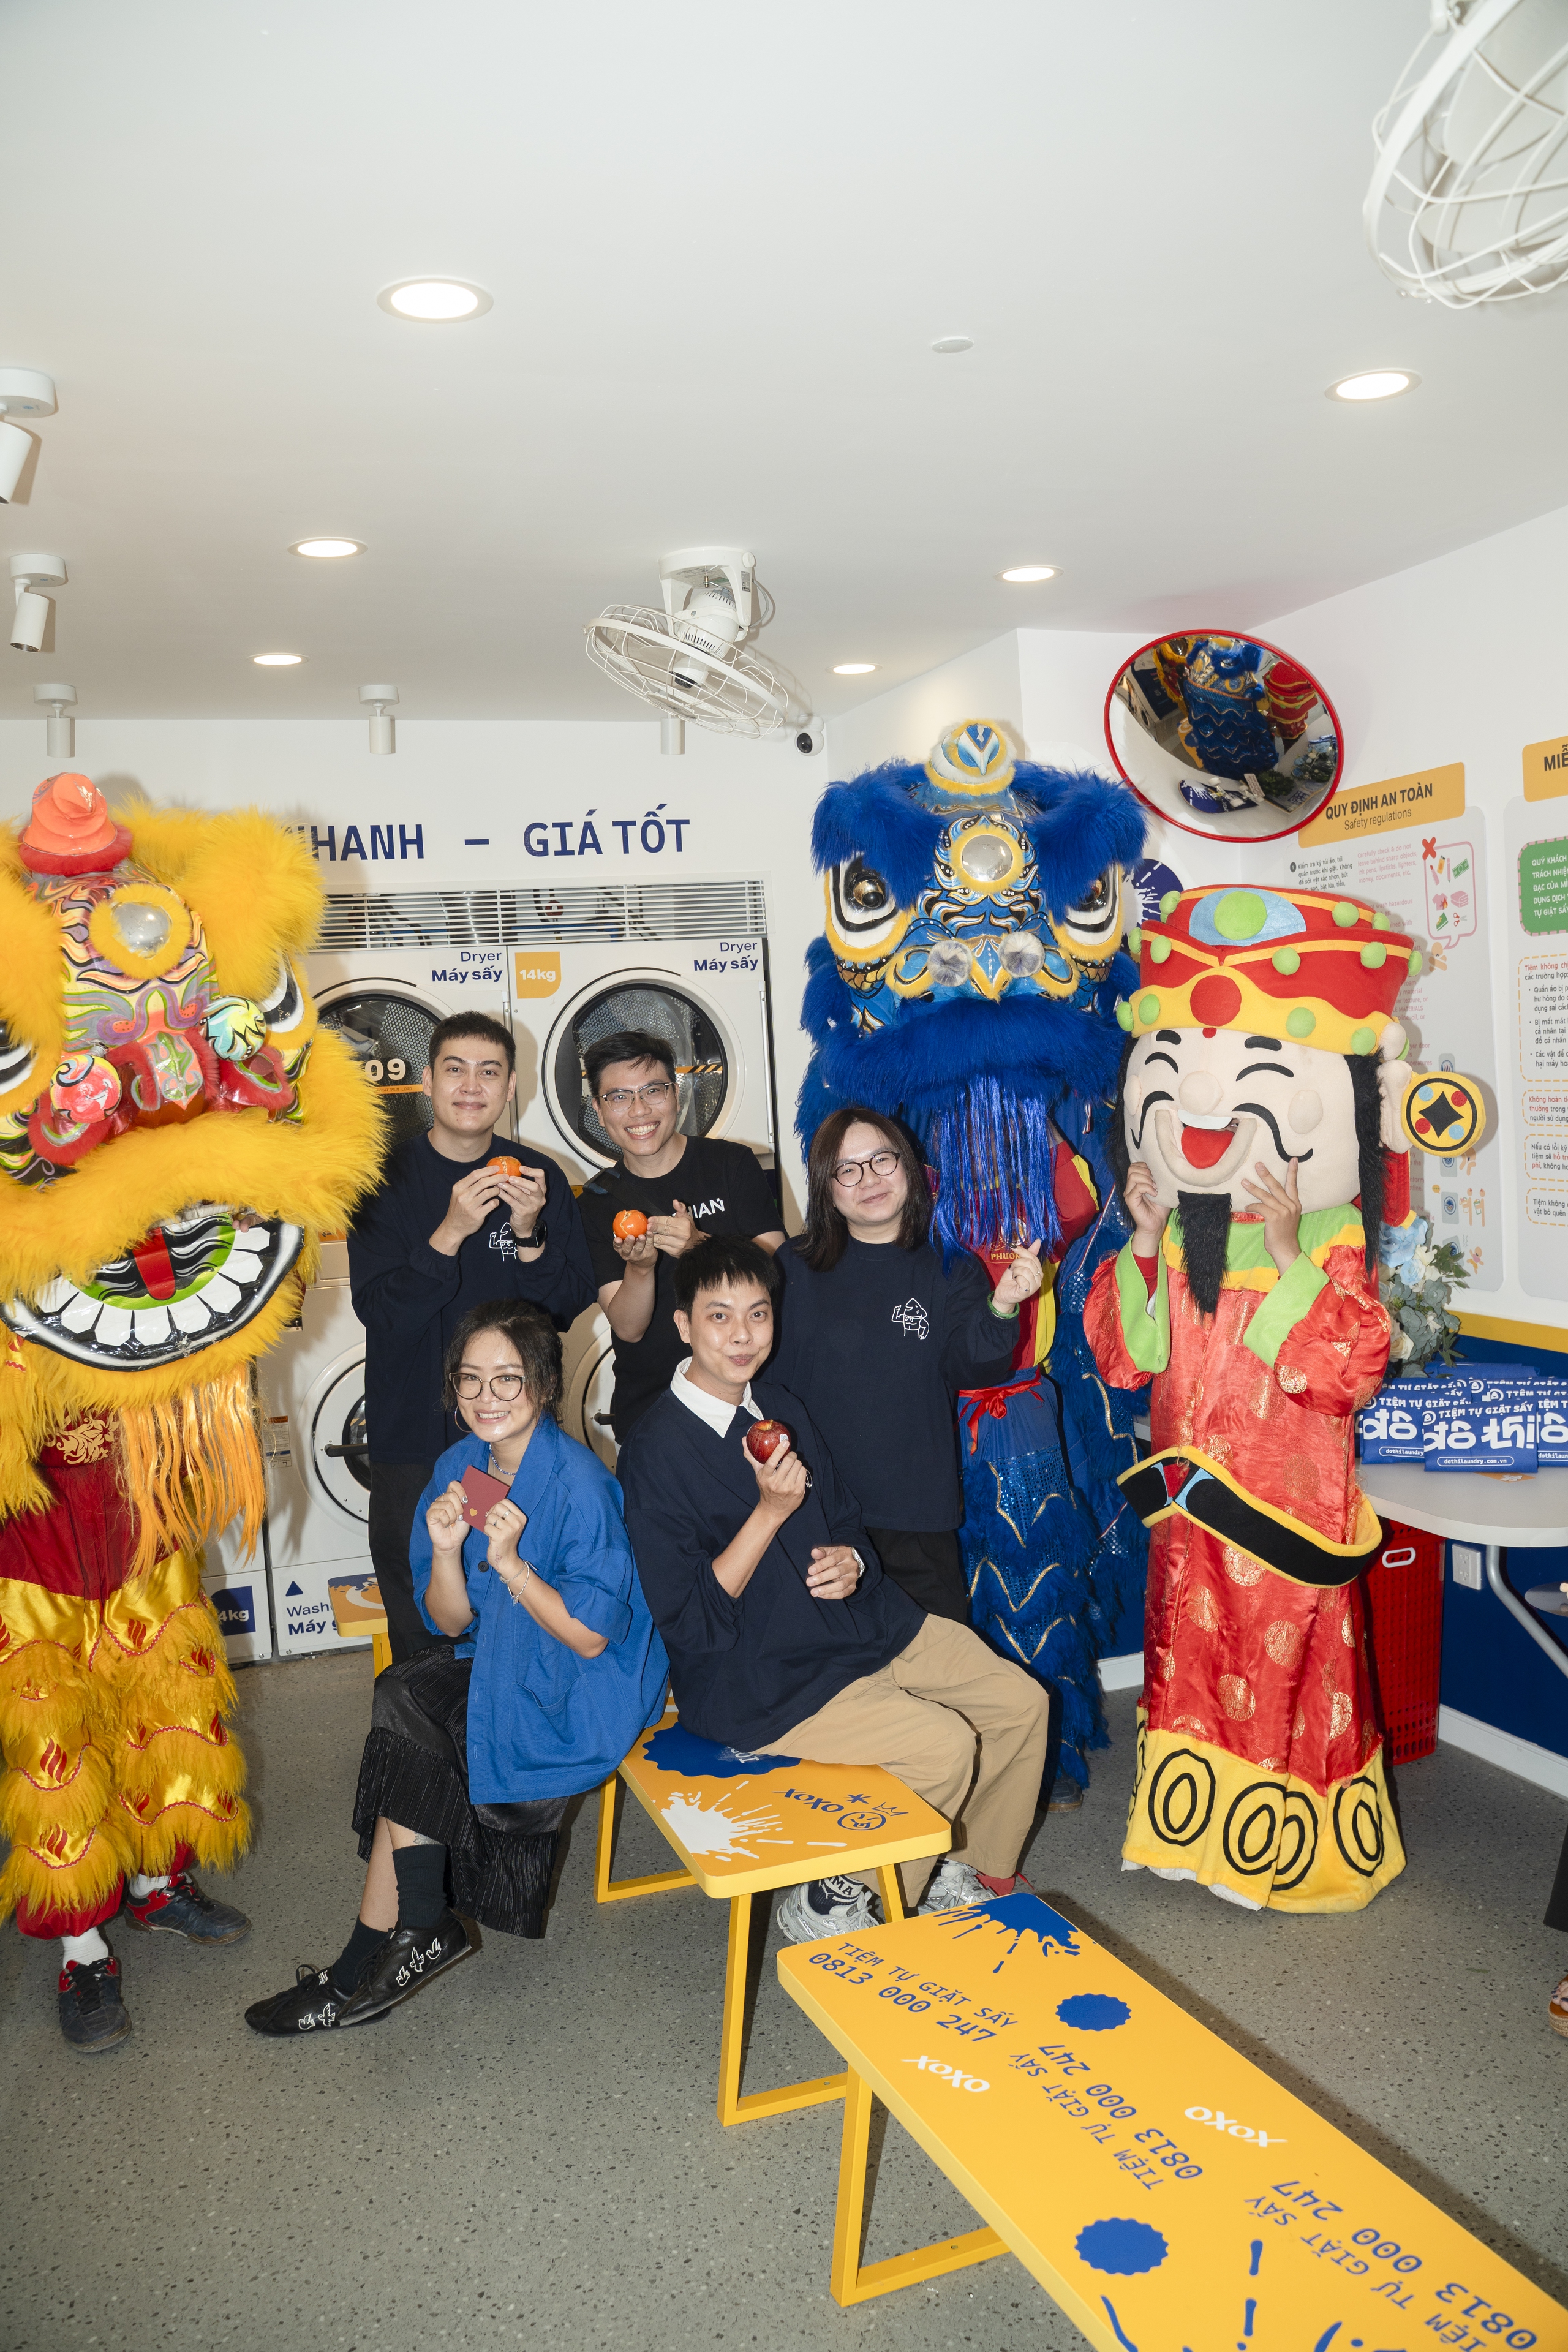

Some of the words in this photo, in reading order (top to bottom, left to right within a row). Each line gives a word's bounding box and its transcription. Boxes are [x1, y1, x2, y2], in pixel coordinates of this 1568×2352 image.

[1544, 744, 1568, 772] MIỄ
[1325, 802, 1349, 820] QUY
[1351, 796, 1378, 816] ĐỊNH
[1381, 791, 1396, 807] AN
[1400, 782, 1433, 804] TOÀN
[1344, 818, 1368, 831] Safety
[1370, 809, 1412, 826] regulations
[523, 809, 603, 858] GIÁ
[612, 803, 690, 854] TỐT
[1357, 849, 1376, 859] Carefully
[1377, 846, 1390, 855] check
[1370, 856, 1385, 865] behind
[1385, 854, 1399, 864] sharp
[1400, 851, 1418, 860] objects,
[1340, 862, 1352, 872] Không
[1378, 863, 1396, 873] lipsticks,
[1398, 860, 1417, 870] lighters,
[1531, 856, 1545, 866] QUÝ
[1547, 854, 1567, 864] KHÁCH
[1359, 876, 1375, 884] money,
[1376, 872, 1401, 881] documents,
[1532, 869, 1551, 879] TRÁCH
[1533, 884, 1545, 893] ĐẠC
[1546, 881, 1559, 890] CỦA
[1534, 896, 1550, 906] DỤNG
[1552, 894, 1566, 904] DỊCH
[1534, 909, 1542, 919] TỰ
[1544, 907, 1557, 918] GIẶT
[720, 942, 757, 954] Dryer
[461, 952, 502, 964] Dryer
[693, 958, 728, 973] Máy
[730, 954, 758, 971] sấy
[431, 968, 469, 984] Máy
[472, 965, 503, 982] sấy
[519, 968, 556, 982] 14kg
[1525, 964, 1538, 973] Tiệm
[1536, 971, 1555, 980] trường
[1558, 984, 1564, 993] bị
[1534, 1005, 1548, 1014] dụng
[1535, 1019, 1540, 1028] Bị
[1542, 1016, 1553, 1025] mất
[1547, 1050, 1556, 1060] vật
[365, 1058, 406, 1082] 09
[1536, 1060, 1545, 1069] hại
[1546, 1060, 1558, 1068] máy
[1529, 1095, 1546, 1104] Không
[1529, 1105, 1548, 1114] thường
[1530, 1114, 1545, 1122] người
[1531, 1142, 1542, 1150] Nếu
[1531, 1153, 1544, 1161] tiệm
[1532, 1161, 1542, 1170] phí,
[1544, 1163, 1561, 1171] không
[1533, 1198, 1547, 1208] Tiệm
[1548, 1199, 1566, 1208] không
[1534, 1208, 1542, 1216] vật
[1552, 1209, 1566, 1218] quên
[1379, 1396, 1406, 1409] TIỆM
[1409, 1399, 1422, 1410] TỰ
[1537, 1398, 1559, 1411] IỆM
[1438, 1408, 1466, 1420] TIỆM
[1468, 1408, 1483, 1417] TỰ
[1485, 1404, 1512, 1416] GIẶT
[1513, 1401, 1534, 1413] SẤY
[1363, 1409, 1417, 1440] đô
[1423, 1420, 1476, 1453] đô
[1481, 1415, 1535, 1449] thị
[217, 1609, 249, 1623] 4kg
[288, 1619, 327, 1636] Máy
[837, 1942, 884, 1967] TIỆM
[888, 1966, 920, 1982] TỰ
[919, 1981, 972, 2007] GIẶT
[973, 2007, 1019, 2028] SẤY
[809, 1953, 875, 1985] 0813
[878, 1986, 932, 2013] 000
[936, 2014, 997, 2042] 247
[1008, 2053, 1049, 2078] SẤY
[1037, 2044, 1091, 2076] 247
[1041, 2084, 1090, 2118] GIẶT
[1085, 2084, 1137, 2119] 000
[1080, 2122, 1116, 2145] TỰ
[1133, 2128, 1204, 2180] 0813
[1112, 2148, 1165, 2192] TIỆM
[1269, 2179, 1344, 2222] 247
[1243, 2195, 1298, 2226] SẤY
[1300, 2231, 1370, 2275] GIẶT
[1350, 2226, 1423, 2274] 000
[1370, 2280, 1415, 2310] TỰ
[1434, 2281, 1538, 2350] 0813
[1424, 2312, 1488, 2352] IỆM
